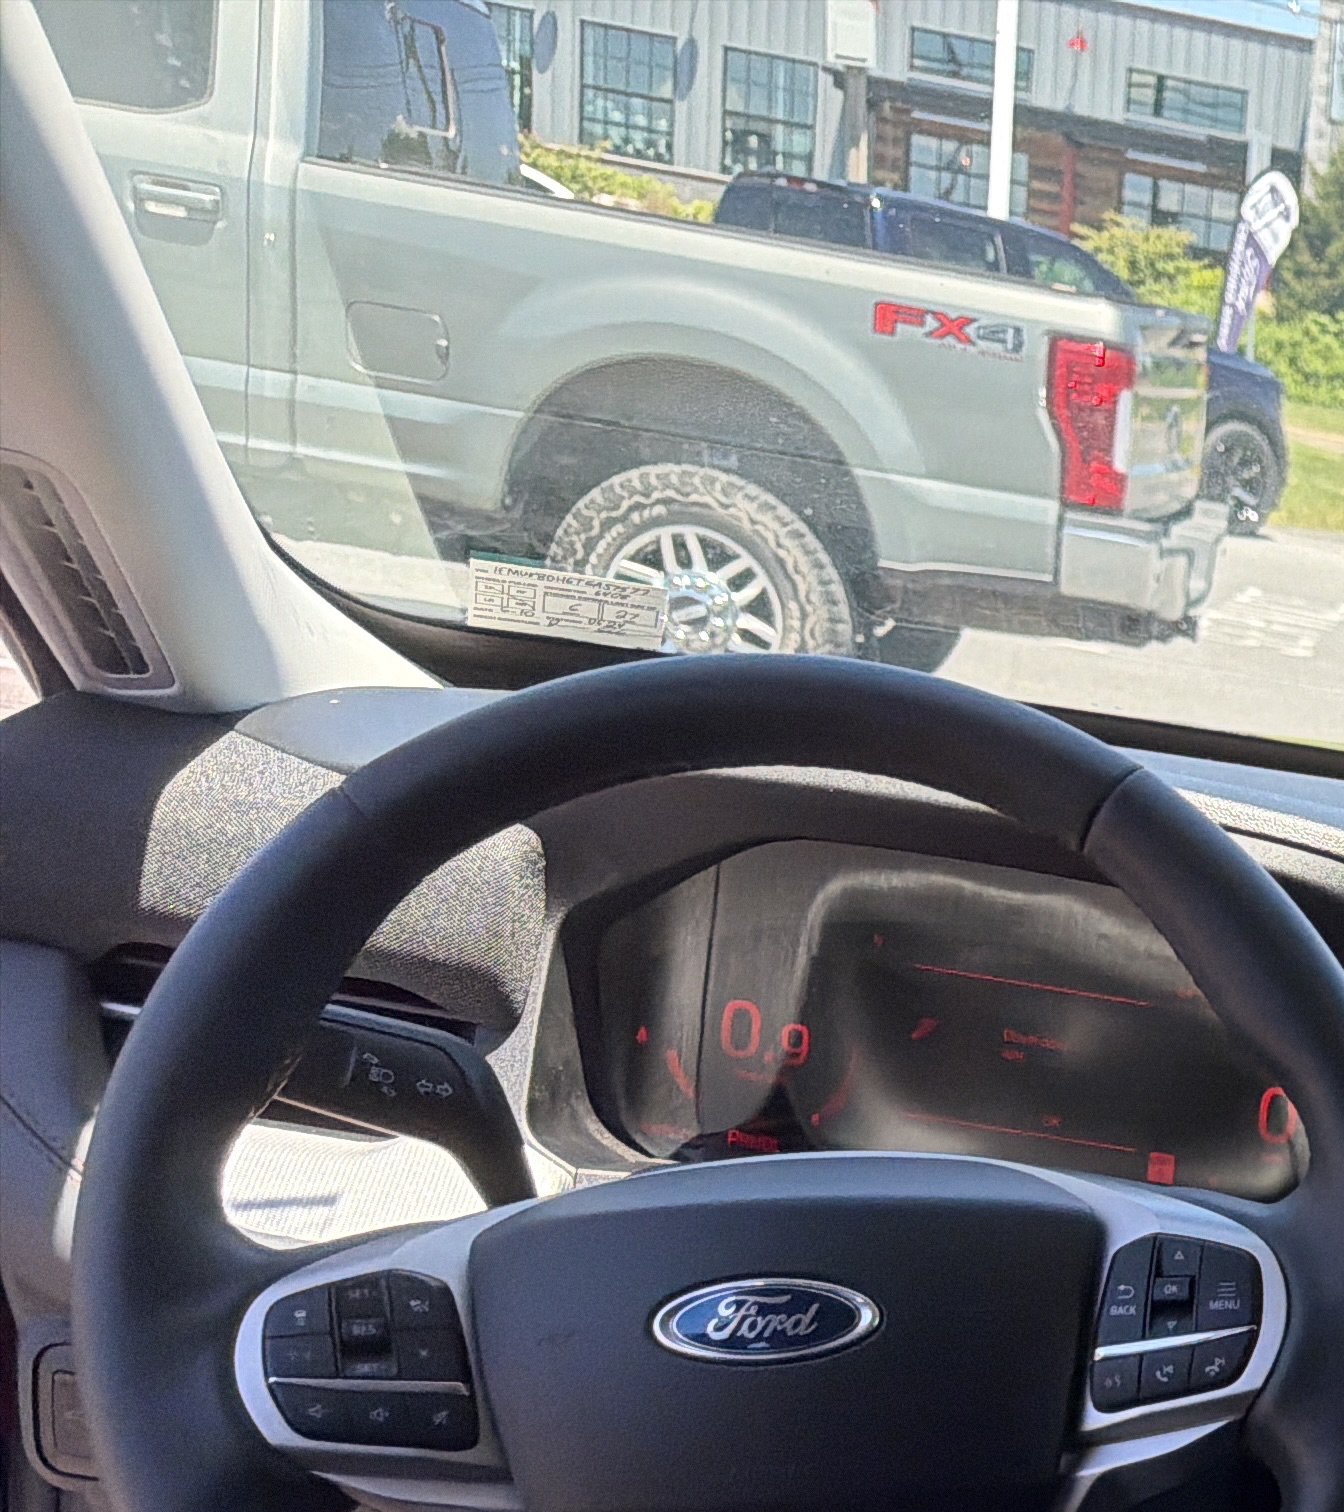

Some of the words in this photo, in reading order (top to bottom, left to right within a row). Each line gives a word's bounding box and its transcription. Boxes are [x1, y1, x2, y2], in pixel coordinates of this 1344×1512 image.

[874, 302, 1024, 353] FX4
[1163, 1284, 1178, 1294] OK
[1209, 1299, 1240, 1310] MENU
[1110, 1306, 1136, 1316] BACK
[706, 1294, 820, 1341] Ford
